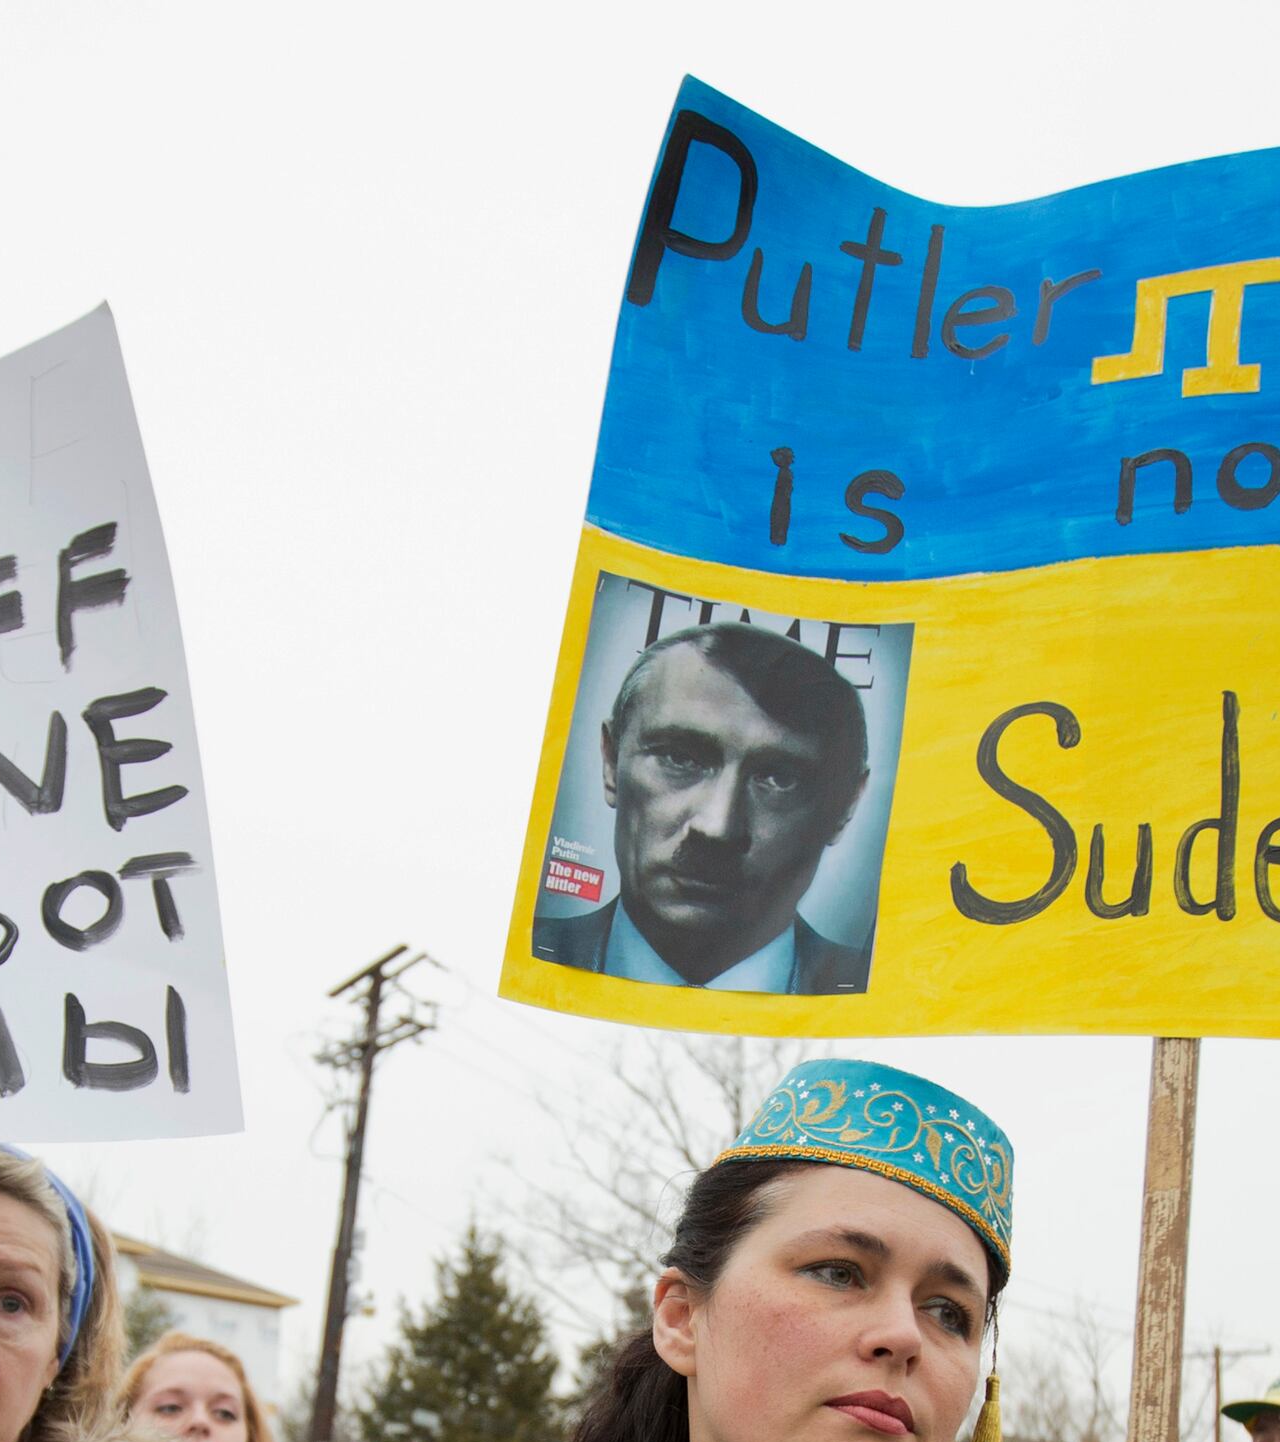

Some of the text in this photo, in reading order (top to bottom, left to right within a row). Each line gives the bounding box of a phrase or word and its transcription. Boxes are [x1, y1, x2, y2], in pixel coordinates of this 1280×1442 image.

[625, 108, 1103, 362] Putler
[768, 446, 906, 555] is
[626, 578, 881, 690] TE
[545, 875, 582, 895] Hitler
[549, 861, 600, 885] The new
[551, 846, 580, 860] Putin
